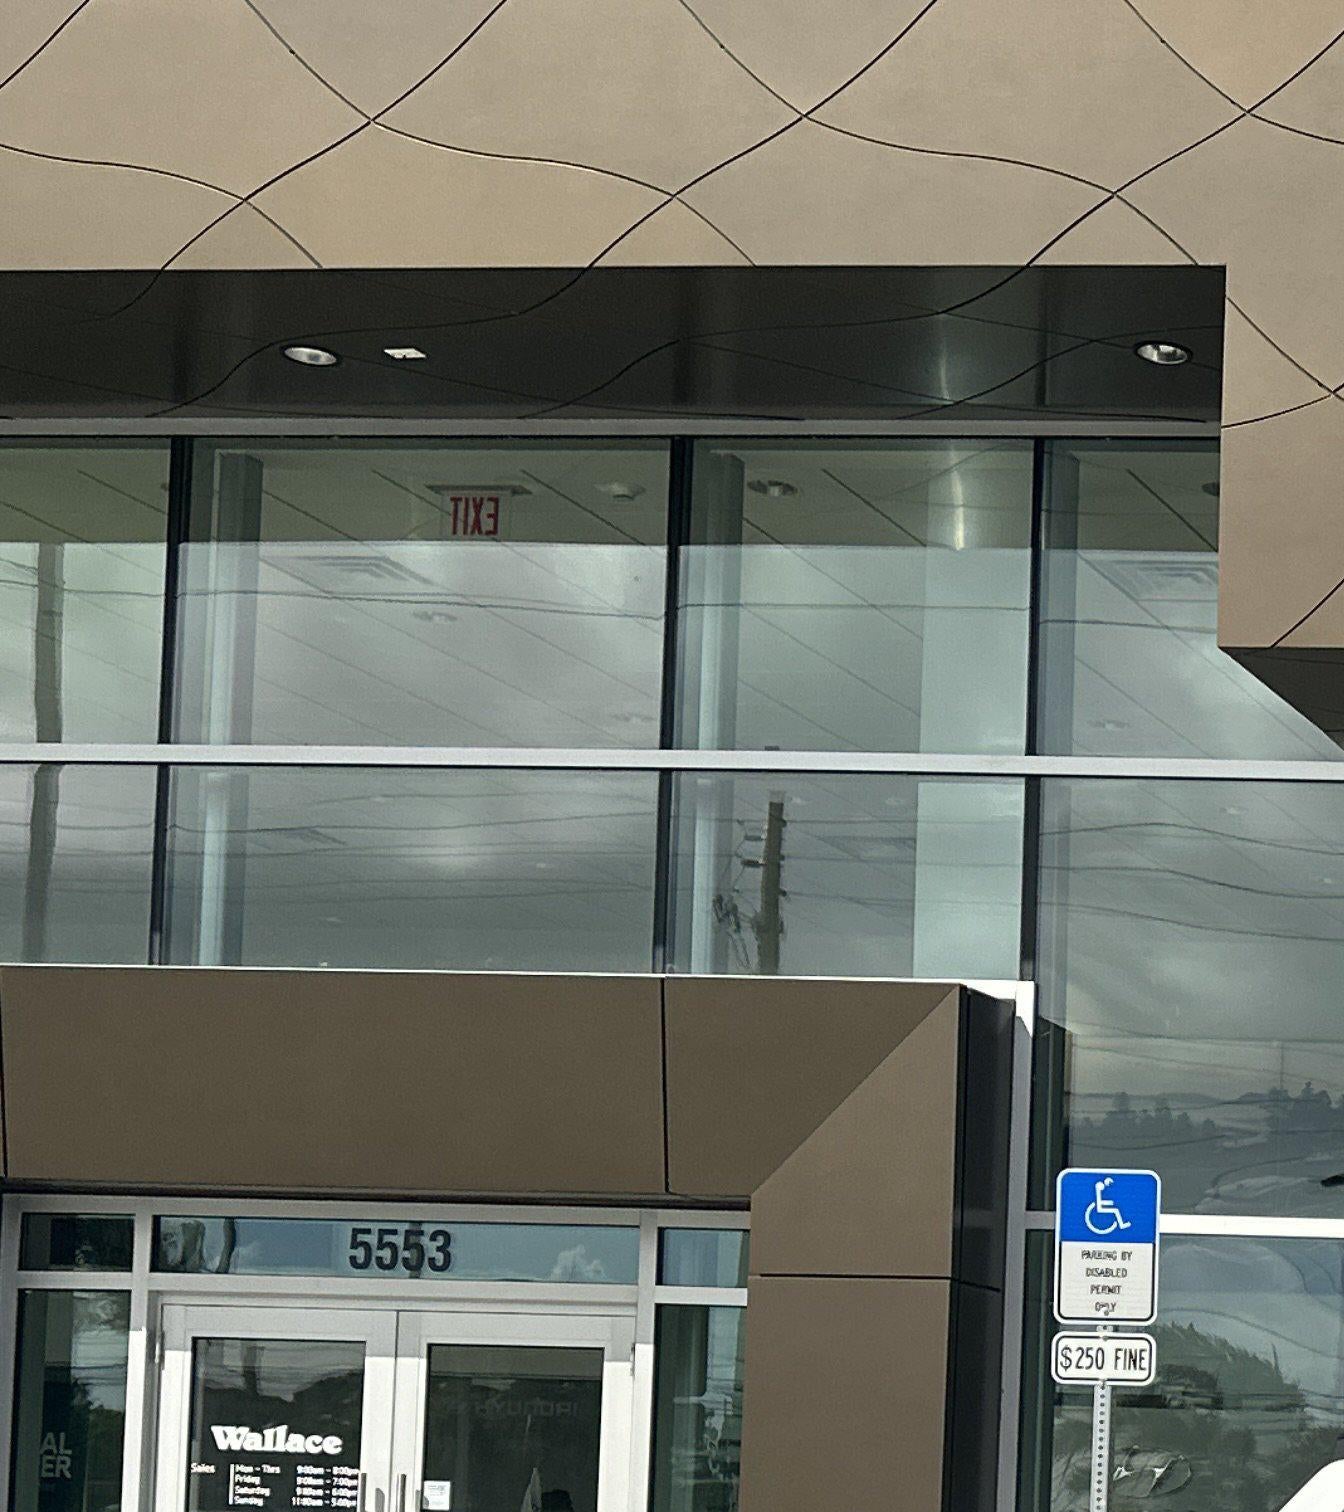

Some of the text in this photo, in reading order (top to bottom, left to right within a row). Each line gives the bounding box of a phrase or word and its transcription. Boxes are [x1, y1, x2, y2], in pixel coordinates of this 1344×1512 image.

[349, 1228, 451, 1272] 5553
[1081, 1250, 1132, 1261] PARKING BY
[1086, 1268, 1128, 1278] DISABLED
[1090, 1285, 1121, 1295] PERMIT
[1060, 1345, 1147, 1371] $250 FINE
[210, 1424, 343, 1454] Wallace
[191, 1463, 216, 1473] Sales
[235, 1465, 254, 1473] Mon
[235, 1474, 260, 1485] Friday
[234, 1486, 270, 1497] Saturday
[234, 1496, 263, 1507] Sunday
